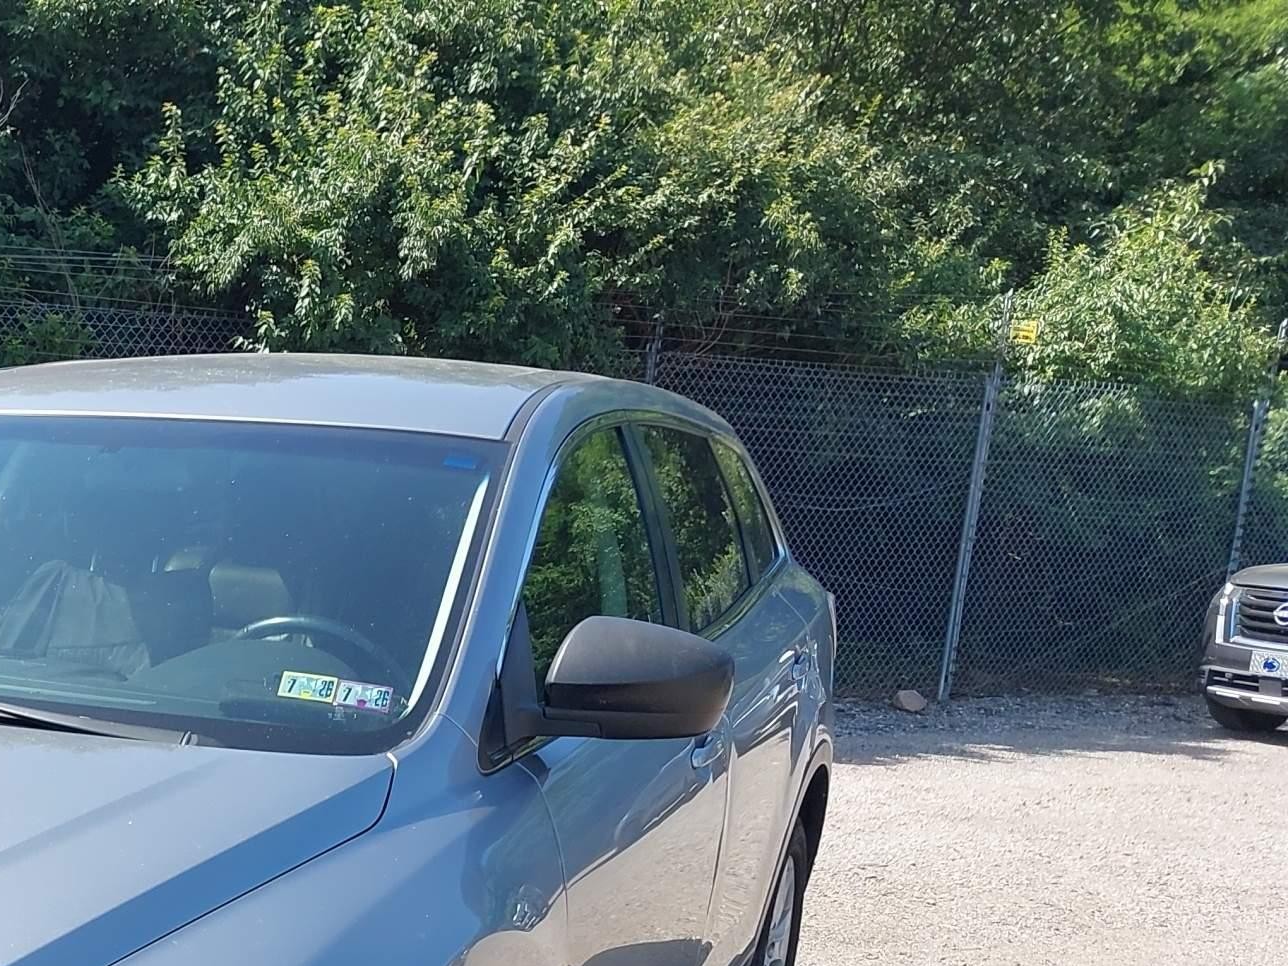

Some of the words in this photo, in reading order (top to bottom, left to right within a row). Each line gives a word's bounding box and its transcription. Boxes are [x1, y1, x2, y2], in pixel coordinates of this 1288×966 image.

[287, 678, 297, 693] 7
[342, 687, 353, 702] 7
[374, 689, 390, 707] 26
